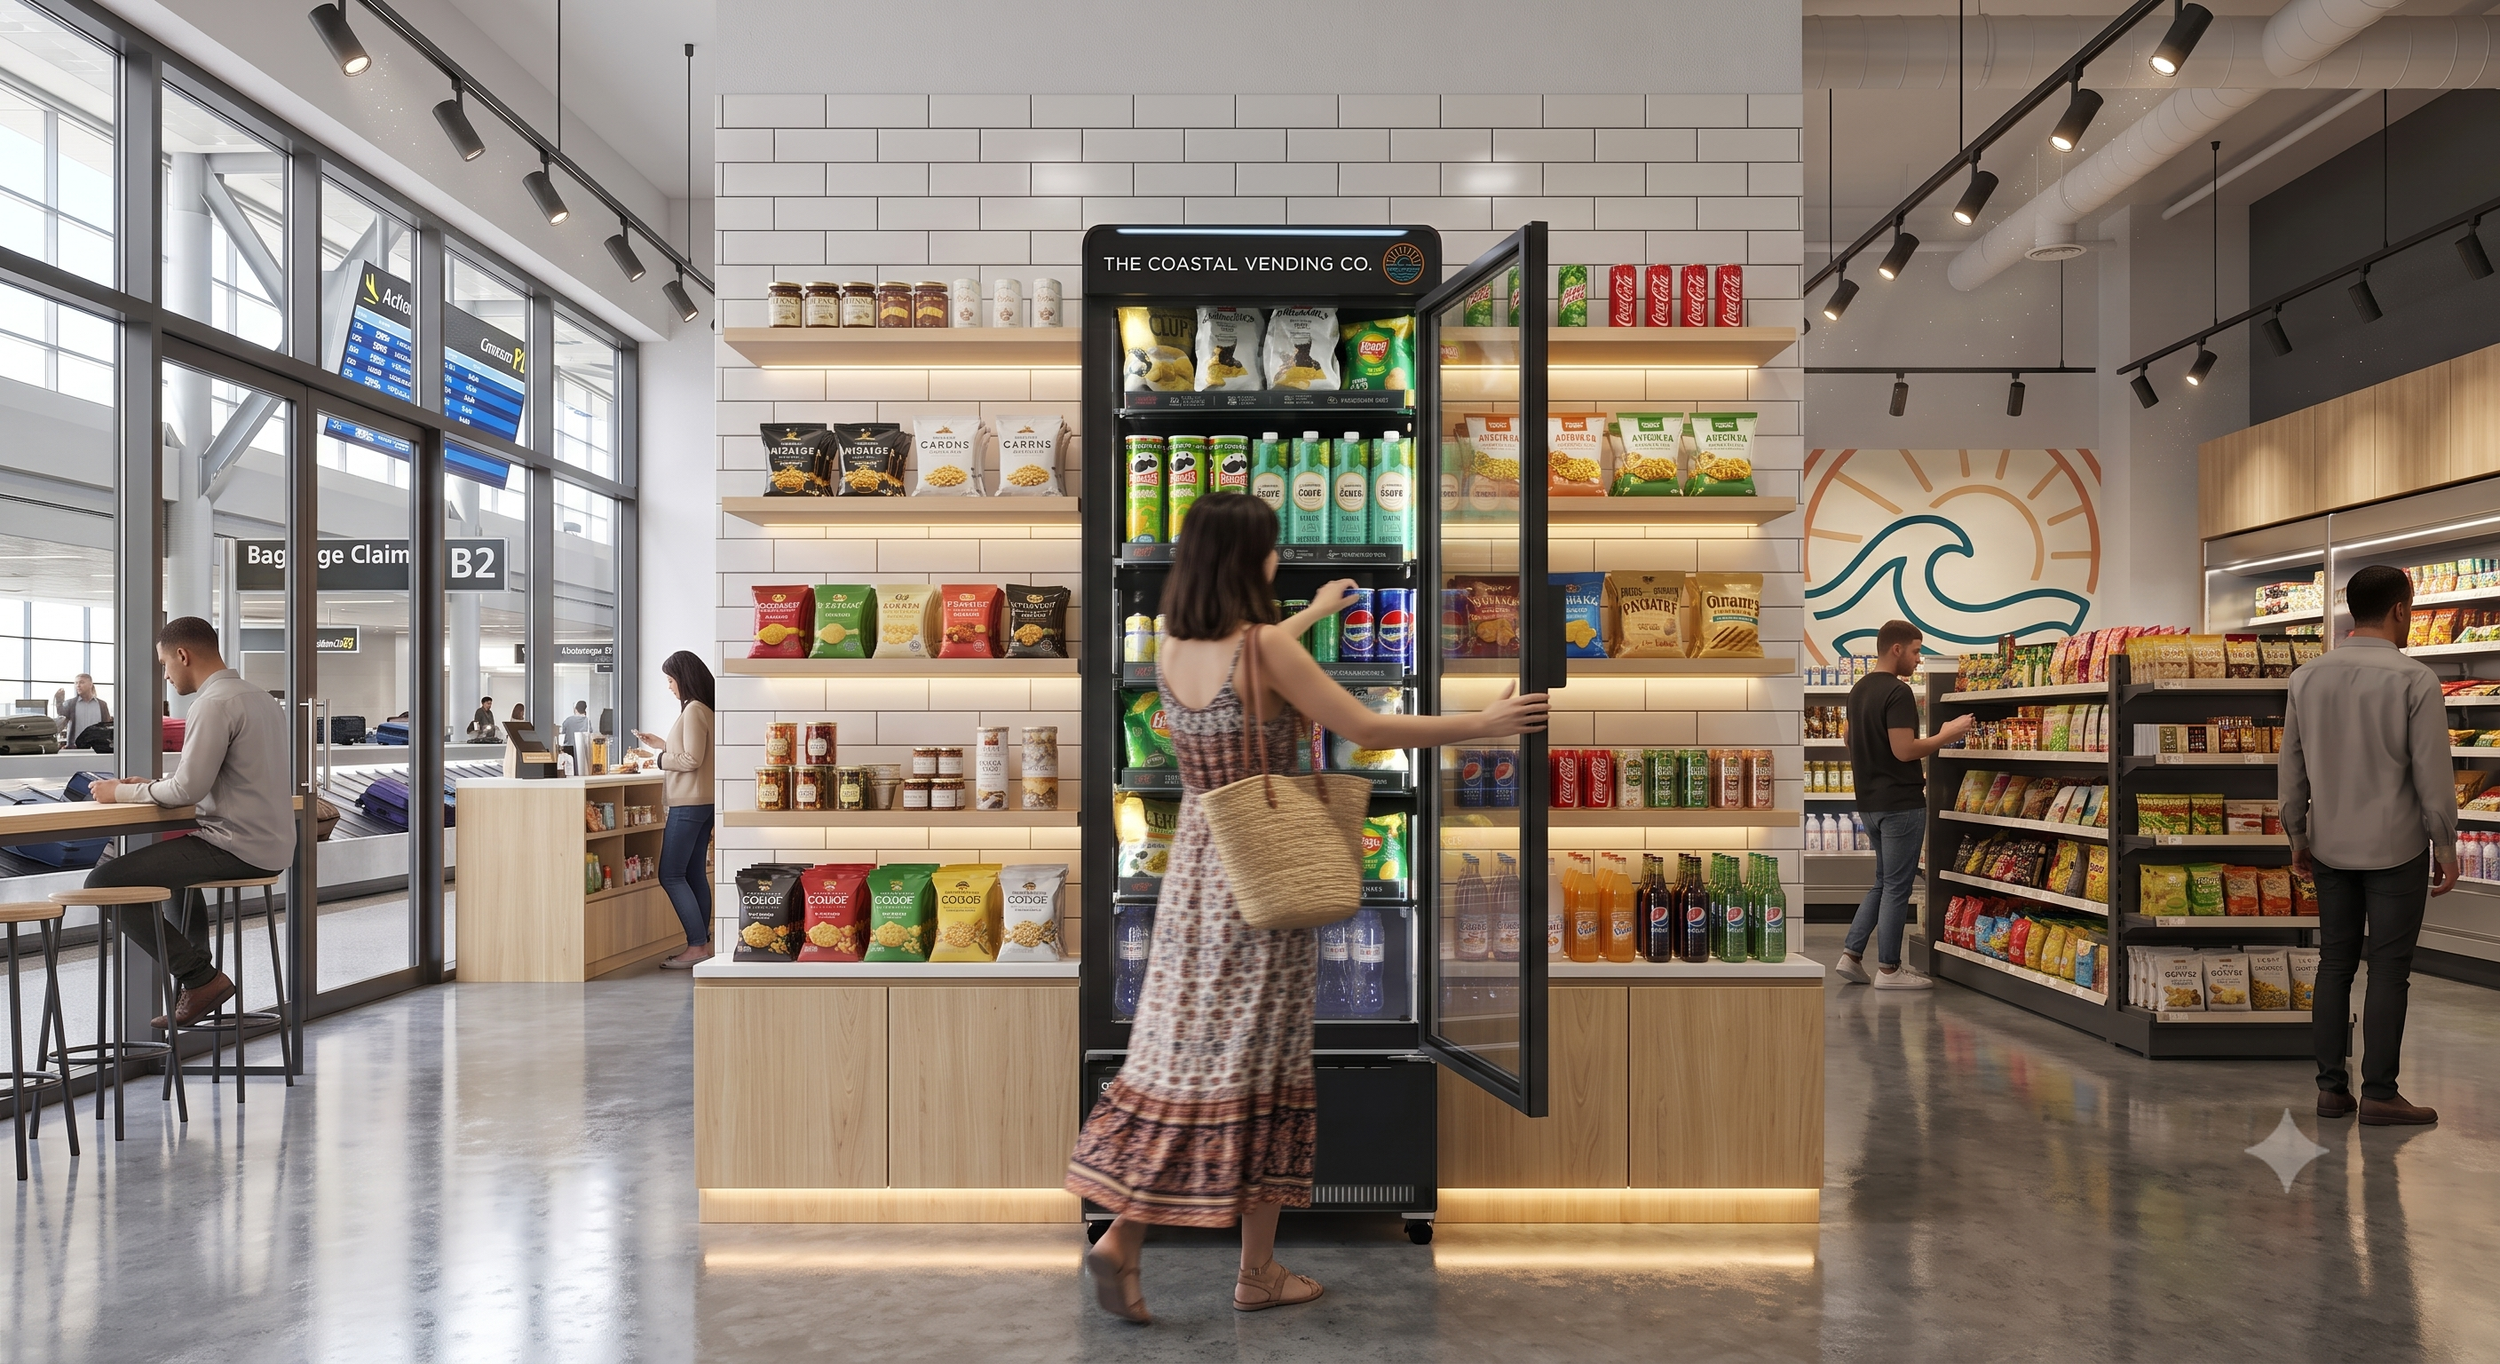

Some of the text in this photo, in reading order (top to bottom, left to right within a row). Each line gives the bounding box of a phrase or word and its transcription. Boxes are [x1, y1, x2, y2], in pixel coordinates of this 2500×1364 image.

[1103, 256, 1373, 271] THE COASTAL VENDING CO.
[247, 544, 496, 578] Bagge Claim B2
